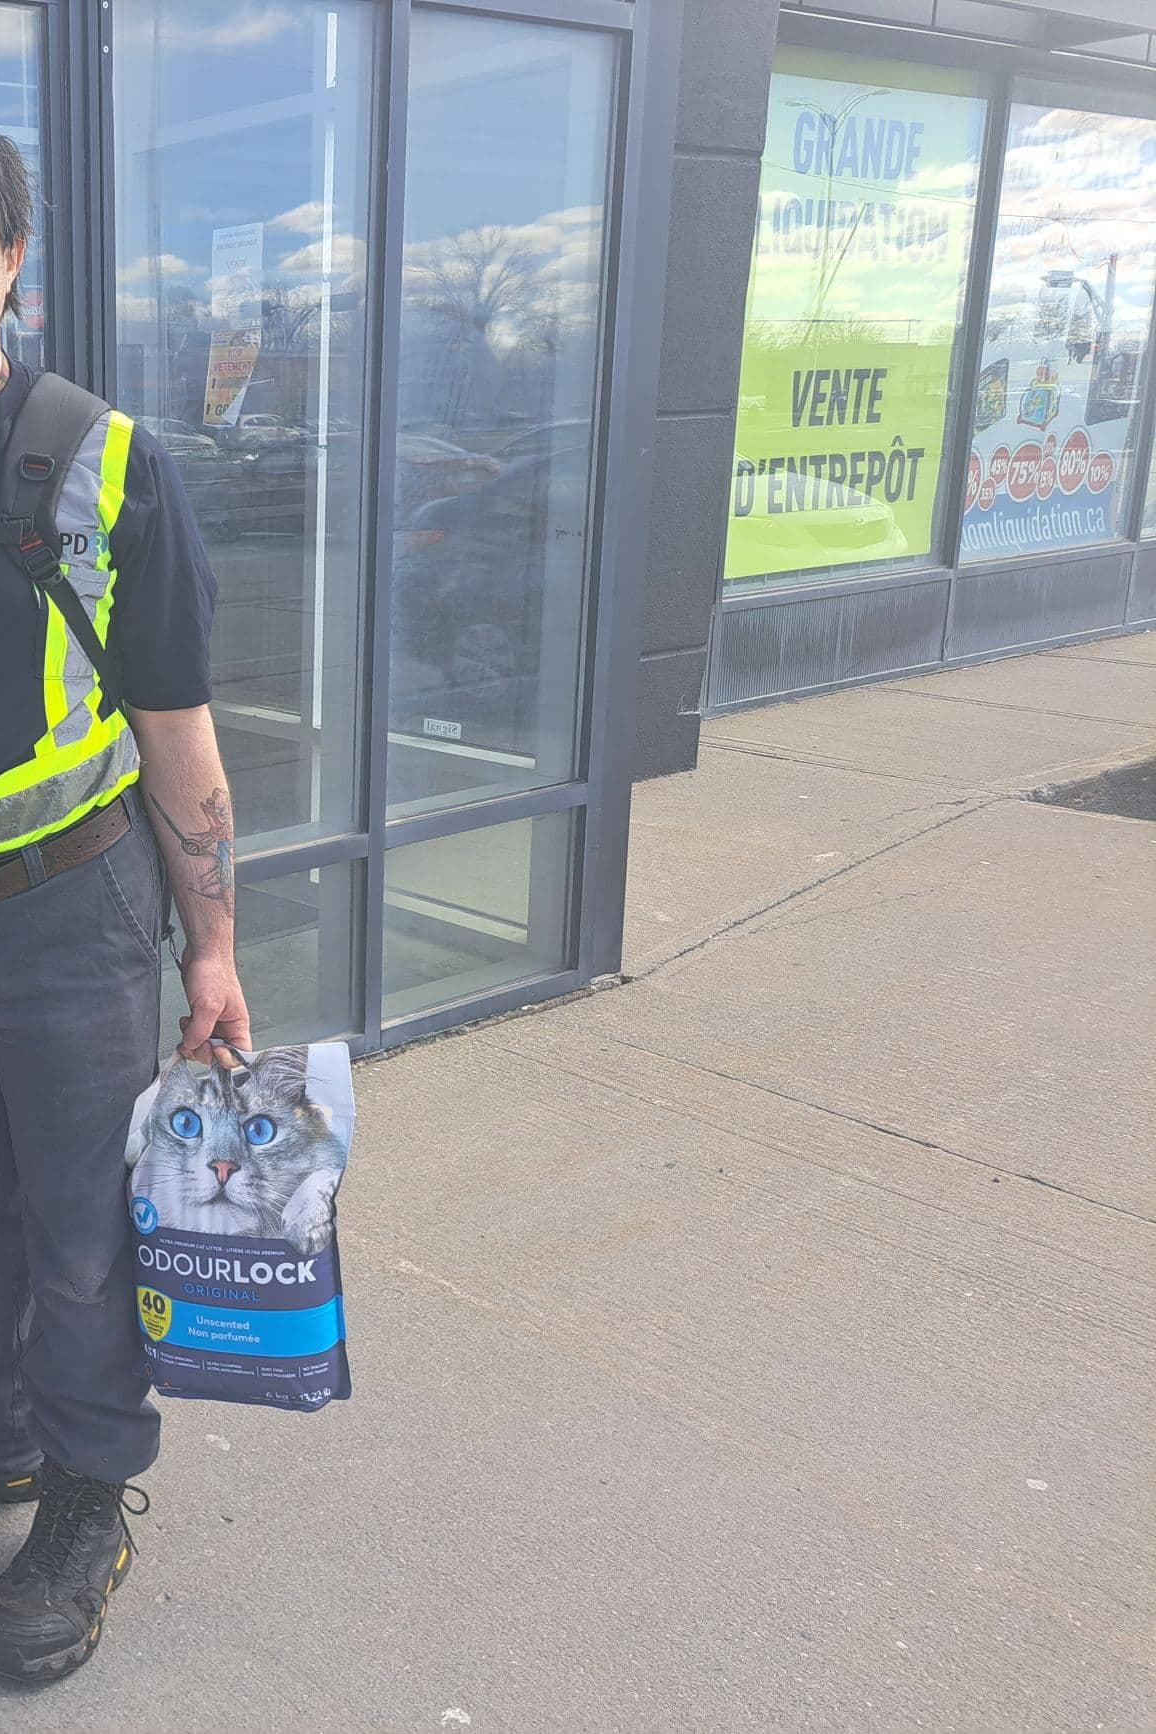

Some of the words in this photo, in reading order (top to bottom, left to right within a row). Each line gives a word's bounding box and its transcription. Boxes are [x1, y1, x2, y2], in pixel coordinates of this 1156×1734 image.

[794, 111, 924, 180] GRANDE
[792, 368, 887, 427] VENTE
[991, 459, 1007, 476] 45%
[1010, 459, 1040, 485] 75%
[1061, 447, 1087, 476] 80%
[1090, 465, 1110, 482] 10%
[734, 435, 925, 517] D'ENTREPÔT
[1038, 469, 1054, 487] 15%
[961, 504, 1105, 550] oomliquidation.ca
[138, 1244, 317, 1284] ODOURLOCK
[142, 1291, 166, 1314] 40
[184, 1283, 260, 1301] ORIGINAL
[196, 1315, 250, 1330] Unscented
[188, 1327, 208, 1337] Non
[211, 1331, 260, 1343] parfumée
